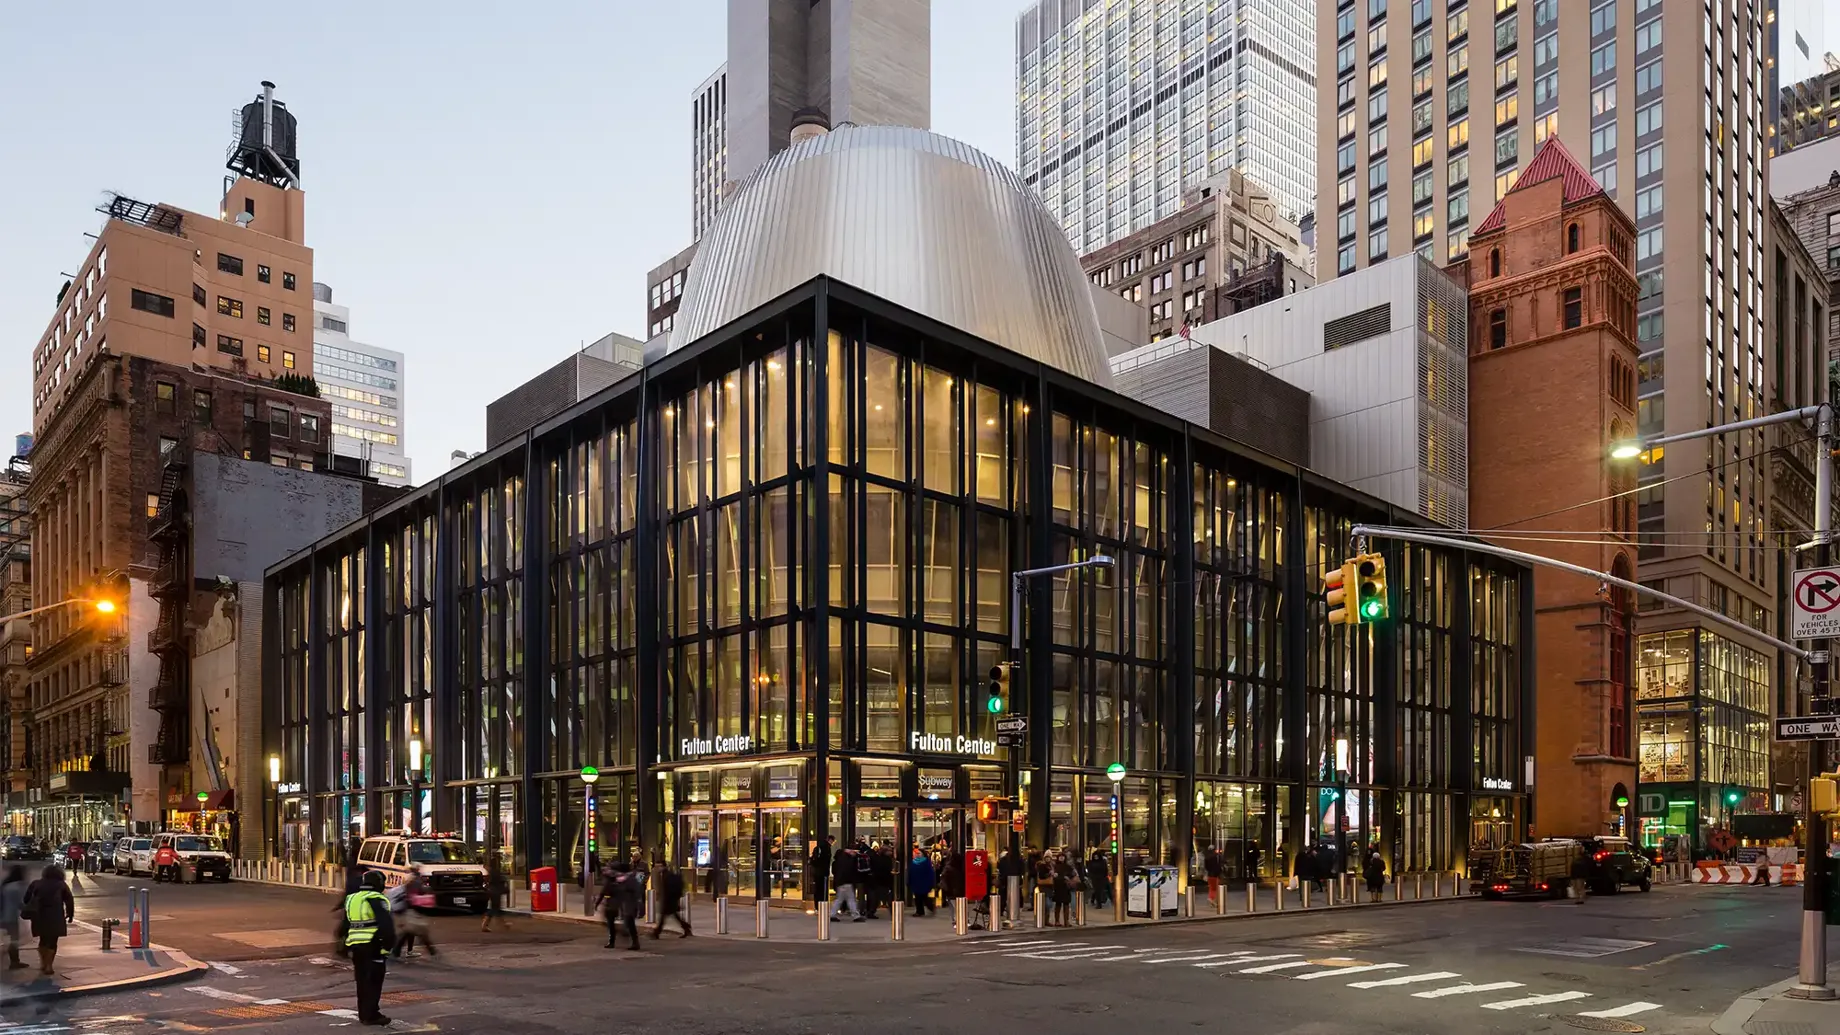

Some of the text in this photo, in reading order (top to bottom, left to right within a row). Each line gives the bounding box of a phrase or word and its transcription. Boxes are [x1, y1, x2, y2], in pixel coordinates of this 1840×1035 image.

[1800, 619, 1839, 629] VEHICLES
[1796, 628, 1817, 636] OVER
[1787, 723, 1840, 734] ONE WA
[682, 734, 750, 756] Fulton Center
[911, 731, 997, 755] Fulton Center
[723, 776, 751, 789] Subway
[919, 774, 953, 789] Subway
[1483, 777, 1512, 790] Fulton Center
[1640, 793, 1665, 812] TD
